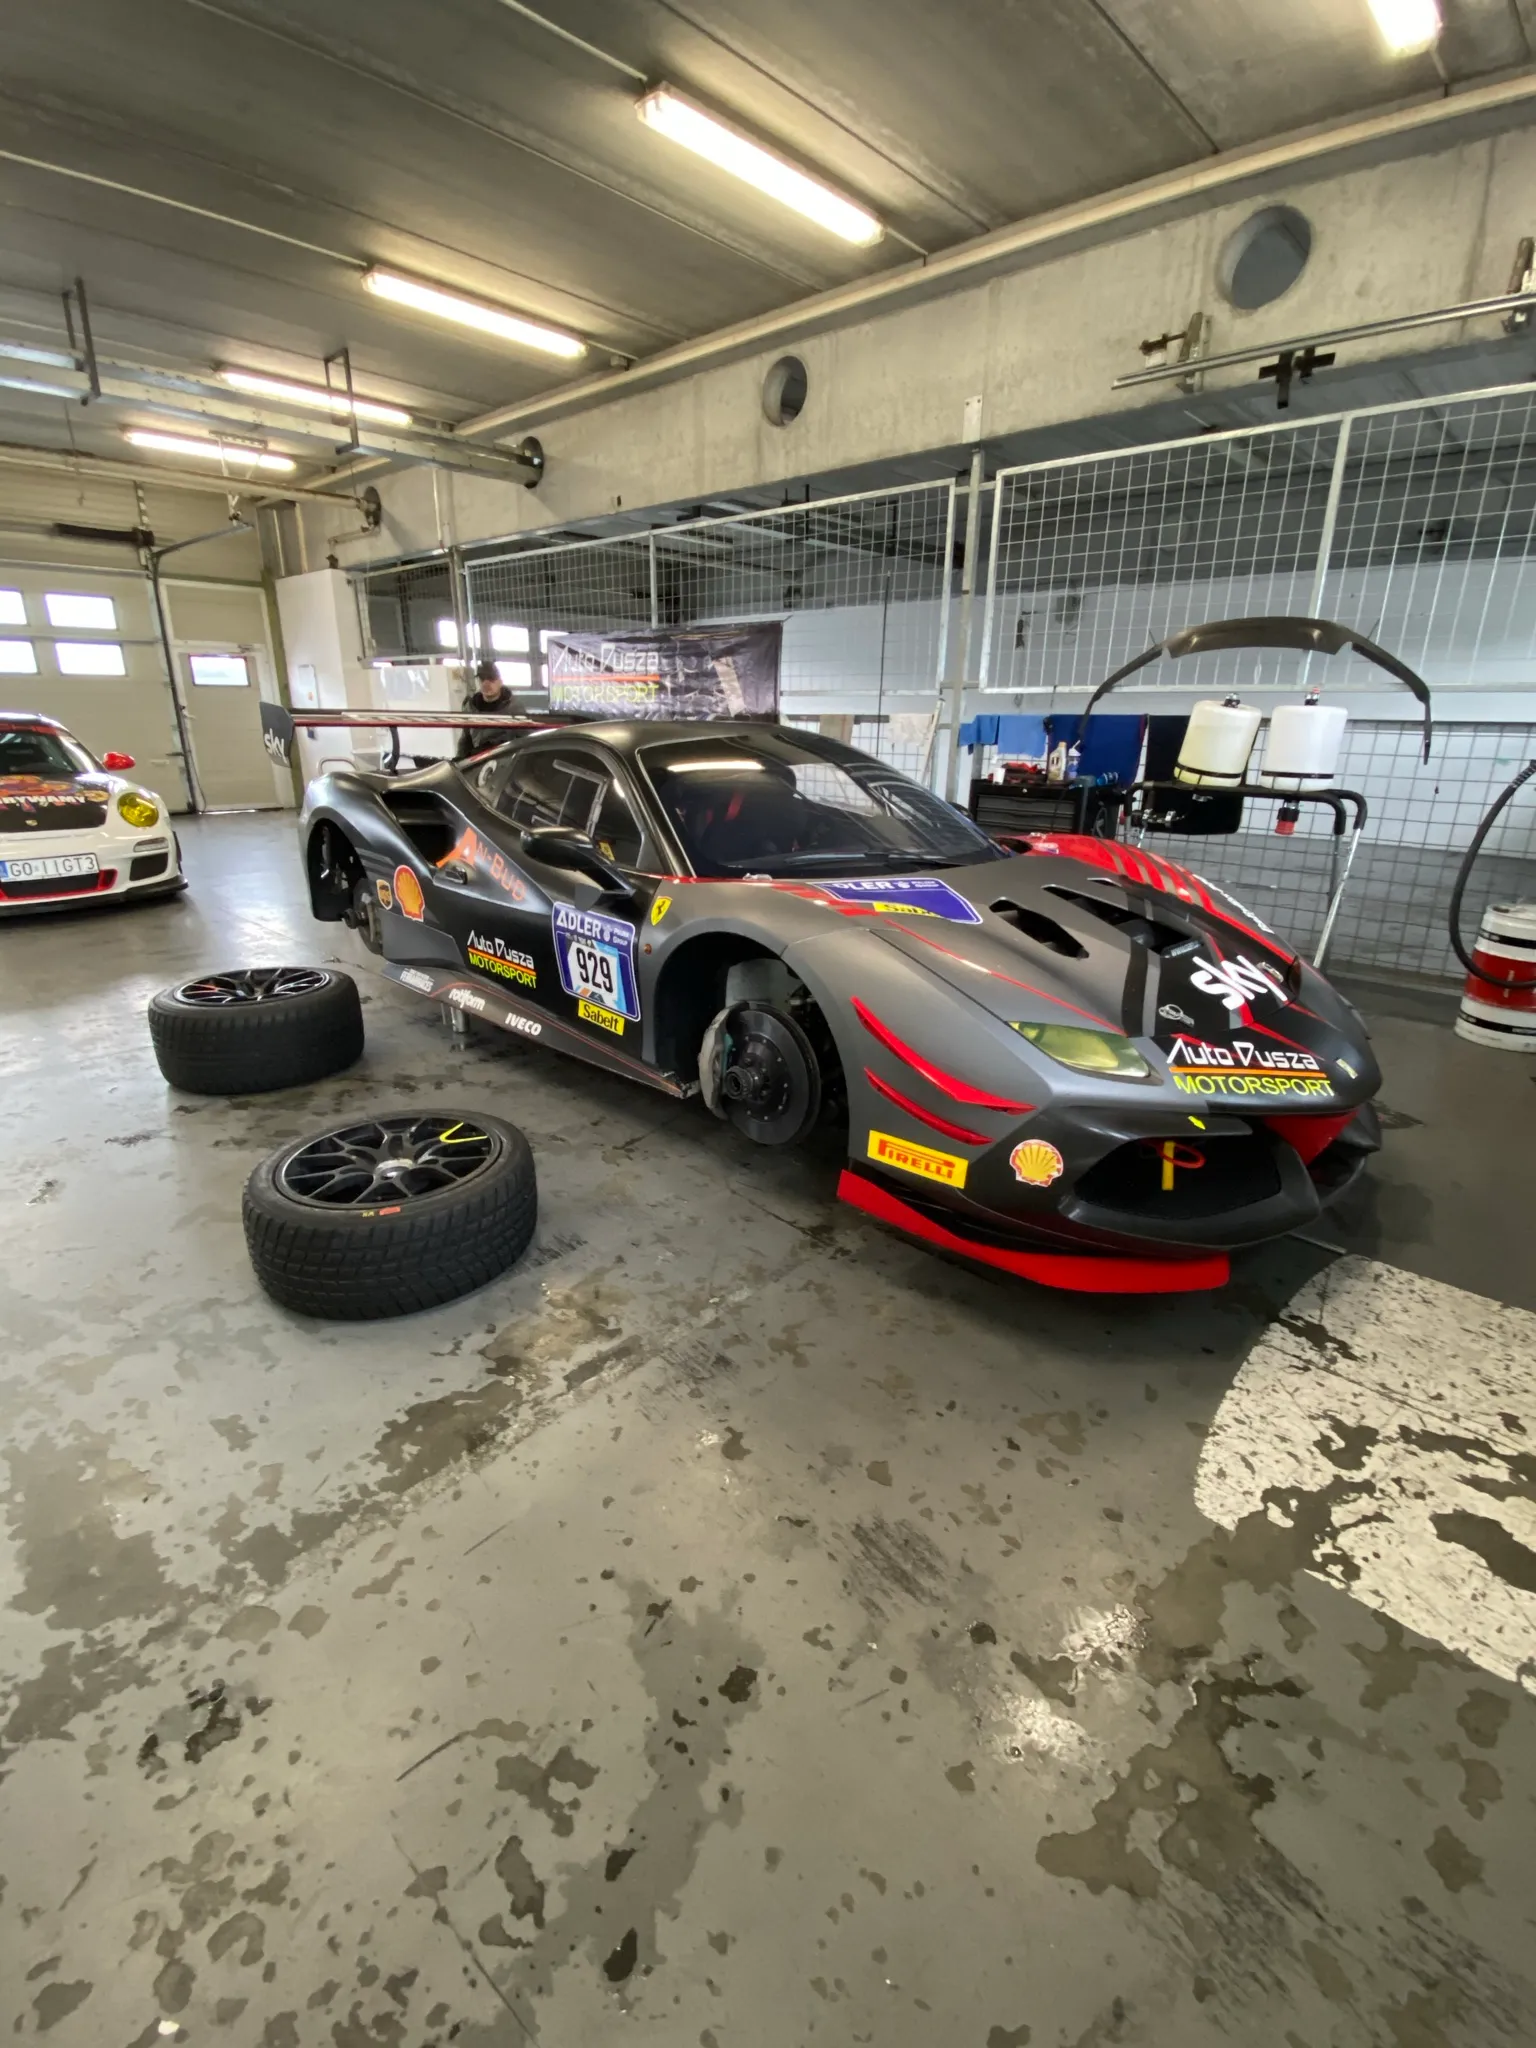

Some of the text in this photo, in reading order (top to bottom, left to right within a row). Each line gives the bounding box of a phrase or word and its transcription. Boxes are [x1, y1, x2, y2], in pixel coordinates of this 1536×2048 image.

[552, 684, 660, 703] MOTORSPORT
[264, 728, 288, 764] sky
[556, 910, 602, 940] ADLER
[494, 937, 535, 970] Dusza
[468, 952, 537, 989] MOTORSPORT
[576, 947, 614, 994] 929
[1190, 954, 1288, 1011] sky
[505, 1012, 542, 1036] IVECO
[583, 1003, 619, 1032] Sabelt
[1167, 1037, 1320, 1071] Auto Dusza
[1173, 1075, 1335, 1098] MOTORSPORT
[878, 1138, 956, 1179] PIRELLI
